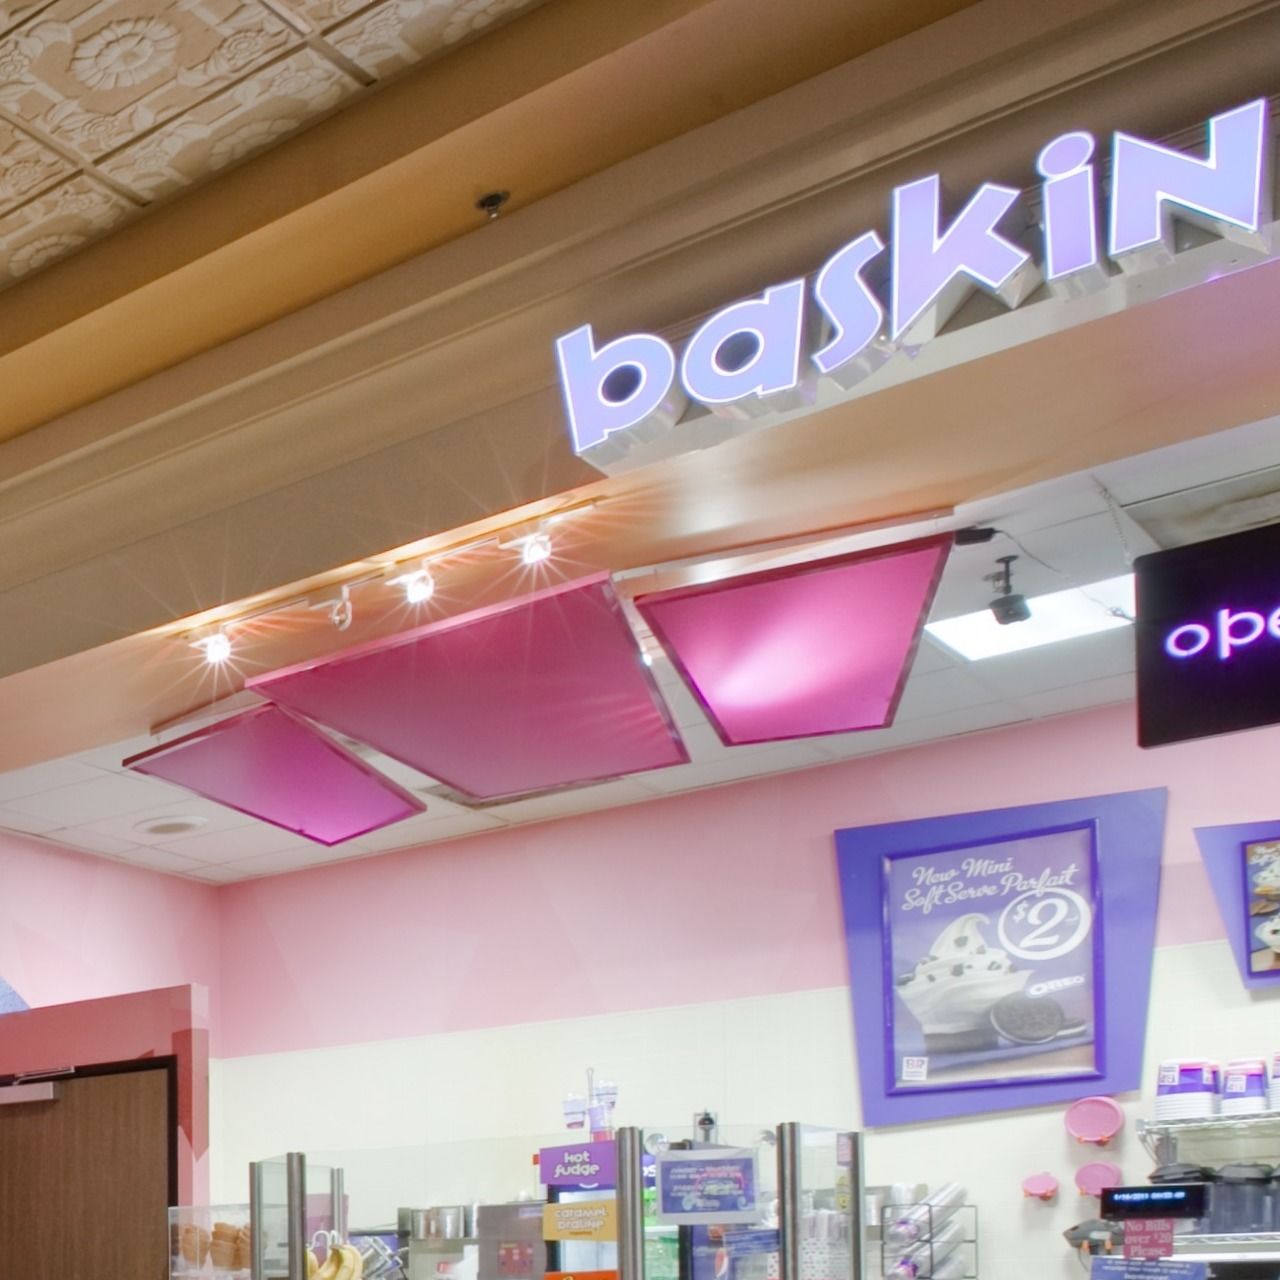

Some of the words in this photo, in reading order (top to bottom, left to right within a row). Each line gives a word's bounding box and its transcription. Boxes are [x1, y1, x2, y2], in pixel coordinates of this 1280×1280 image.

[912, 866, 959, 886] New
[961, 857, 1014, 878] Mini
[902, 886, 944, 914] Soft
[943, 880, 998, 904] Serve
[1000, 864, 1080, 897] Parfait
[1013, 897, 1069, 949] $2
[1029, 975, 1085, 996] OREO
[564, 1151, 590, 1163] hot
[554, 1163, 600, 1178] fudge
[1126, 1221, 1143, 1232] No
[1145, 1221, 1170, 1231] Bills
[1125, 1236, 1151, 1244] over
[1130, 1245, 1167, 1256] Please
